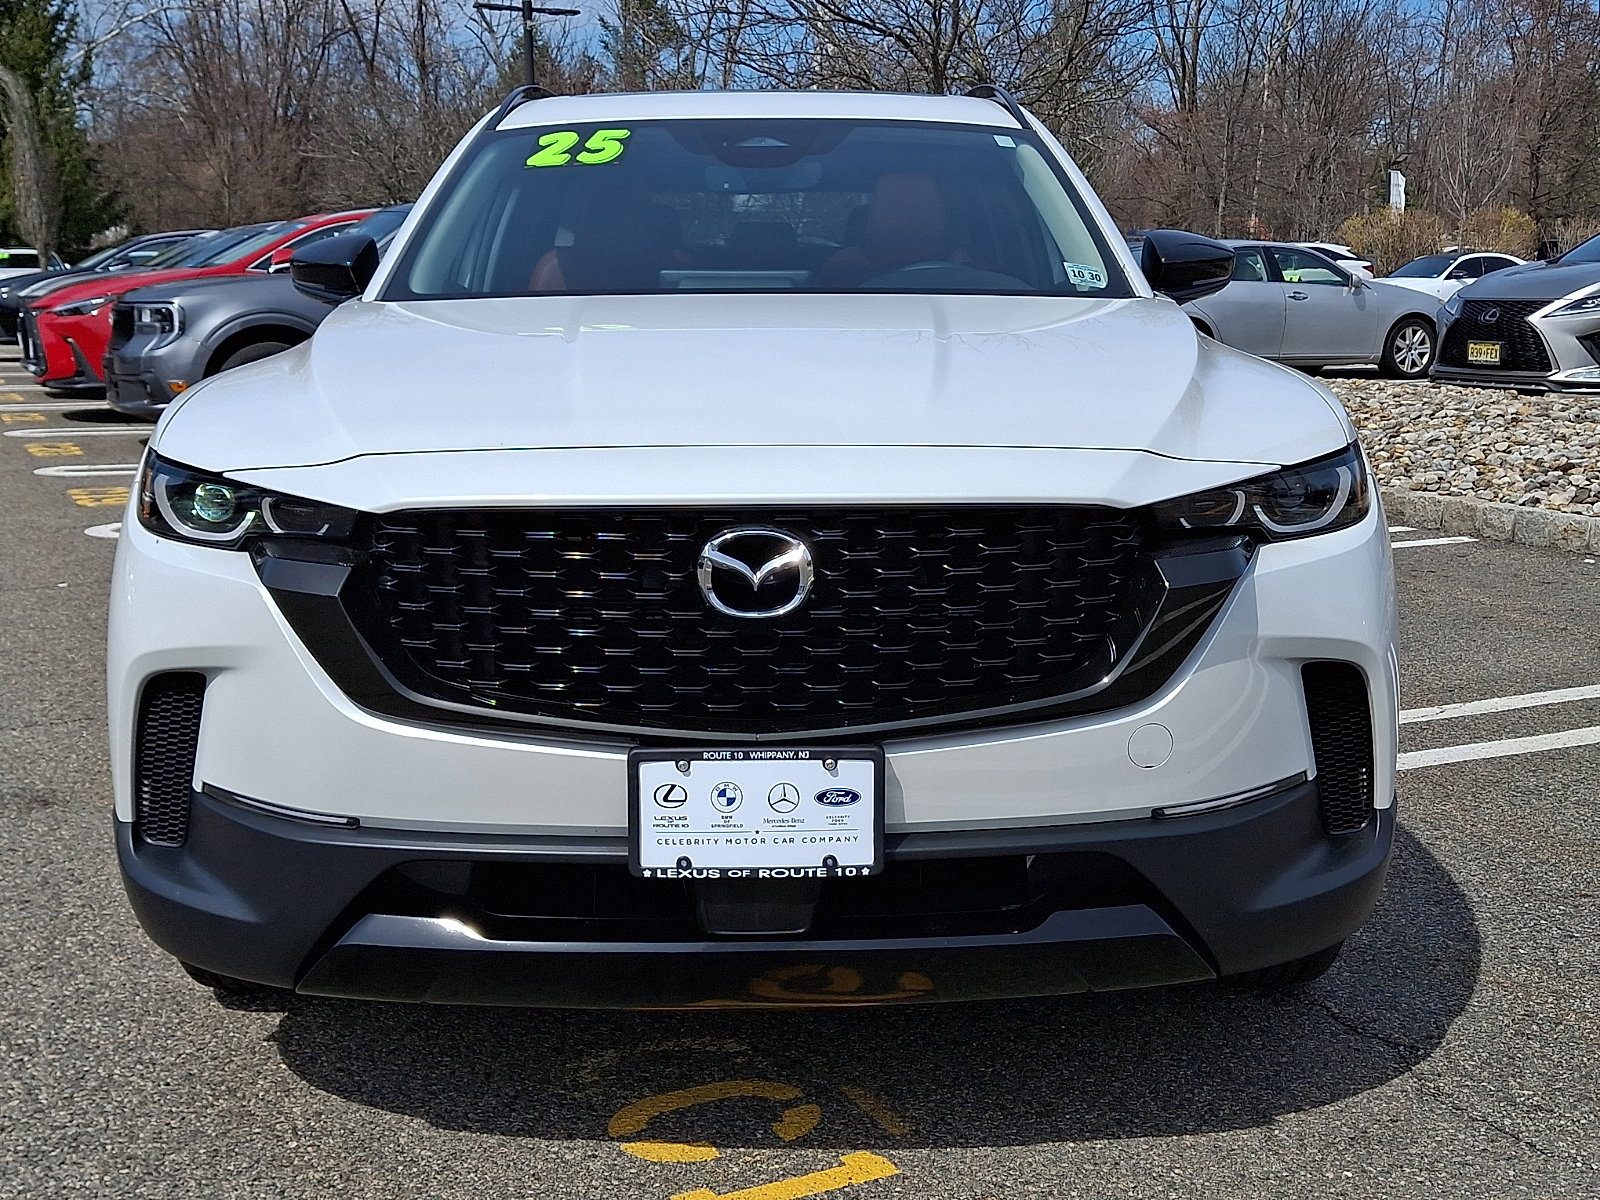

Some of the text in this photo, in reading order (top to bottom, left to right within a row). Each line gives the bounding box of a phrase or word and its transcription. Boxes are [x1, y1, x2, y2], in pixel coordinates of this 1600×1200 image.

[525, 128, 632, 167] 25
[1071, 269, 1102, 282] 10 30
[702, 750, 810, 760] ROUTE 10 WHIPPANY, NJ
[823, 791, 853, 804] Ford
[656, 835, 859, 846] CELEBRITY MOTOR CAR COMPANY
[656, 867, 858, 879] LEXUS OF ROUTE 10
